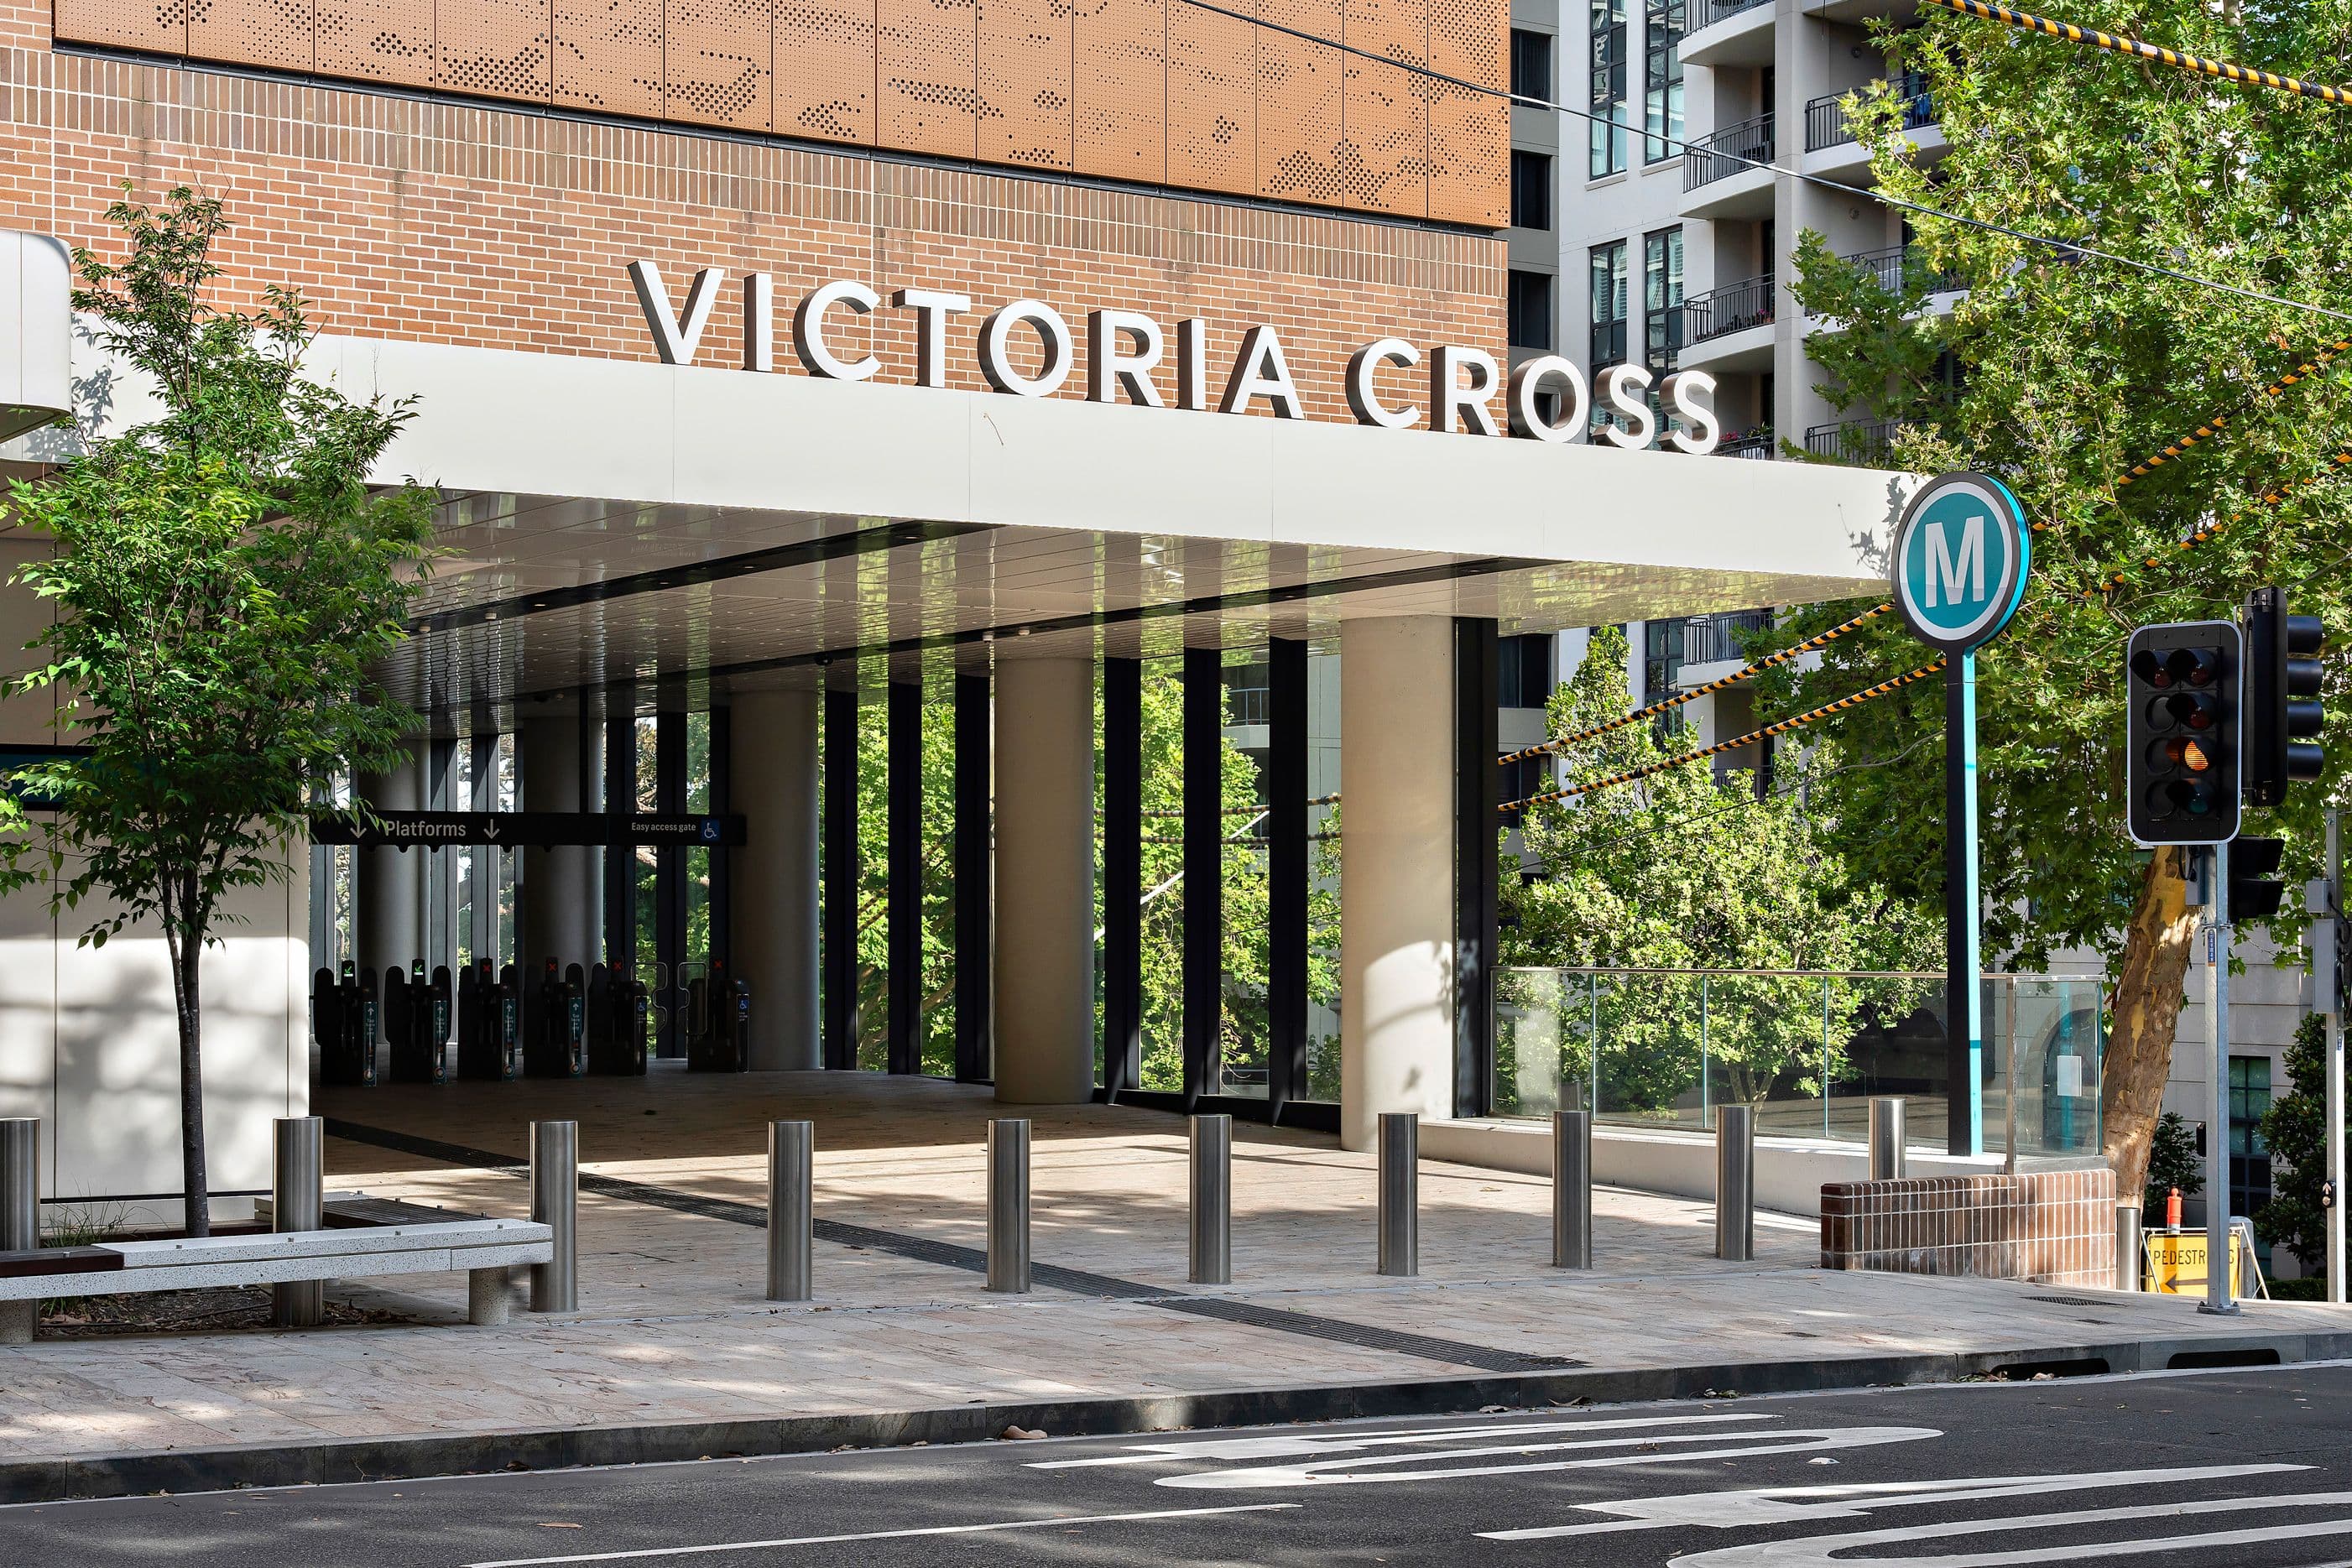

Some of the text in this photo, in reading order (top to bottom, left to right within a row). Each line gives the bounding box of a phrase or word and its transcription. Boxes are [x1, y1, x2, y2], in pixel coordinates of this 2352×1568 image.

[627, 259, 1720, 455] VICTORIA CROSS
[1925, 515, 1984, 608] M
[385, 820, 467, 836] Platforms
[631, 822, 696, 833] Easy access gate
[2153, 1249, 2235, 1265] PEDESTRS
